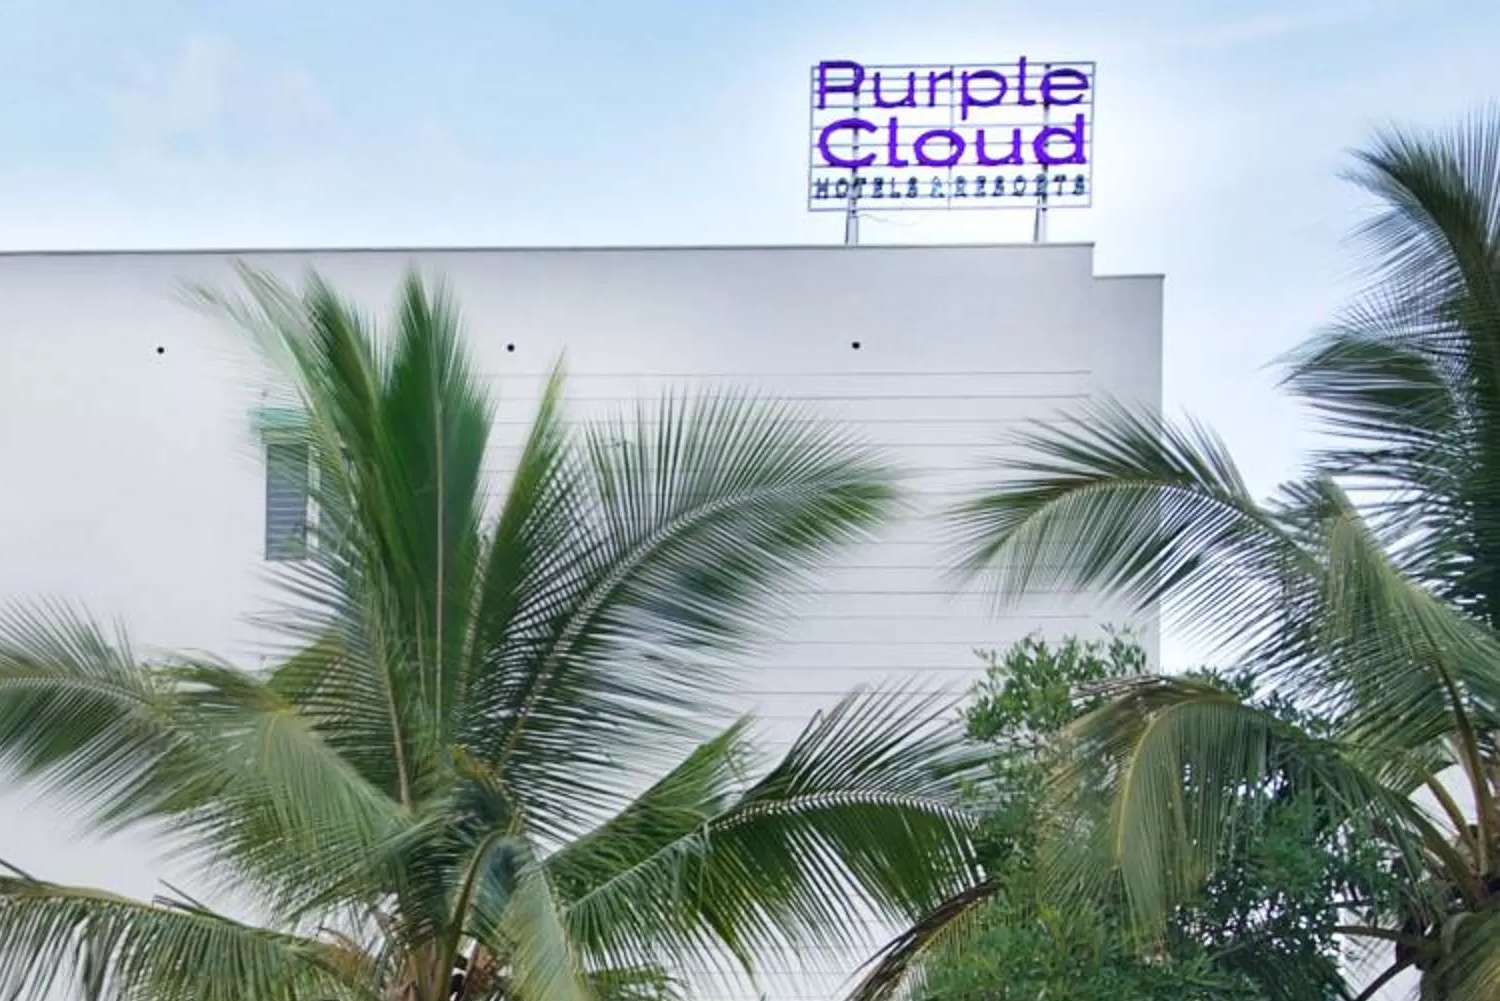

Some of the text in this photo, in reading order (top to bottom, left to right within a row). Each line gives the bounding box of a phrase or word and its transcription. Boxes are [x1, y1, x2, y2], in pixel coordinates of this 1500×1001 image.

[819, 55, 1089, 120] Purple
[818, 113, 1087, 168] Cloud
[815, 176, 918, 199] HOTELS
[955, 173, 1086, 197] RESORTS
